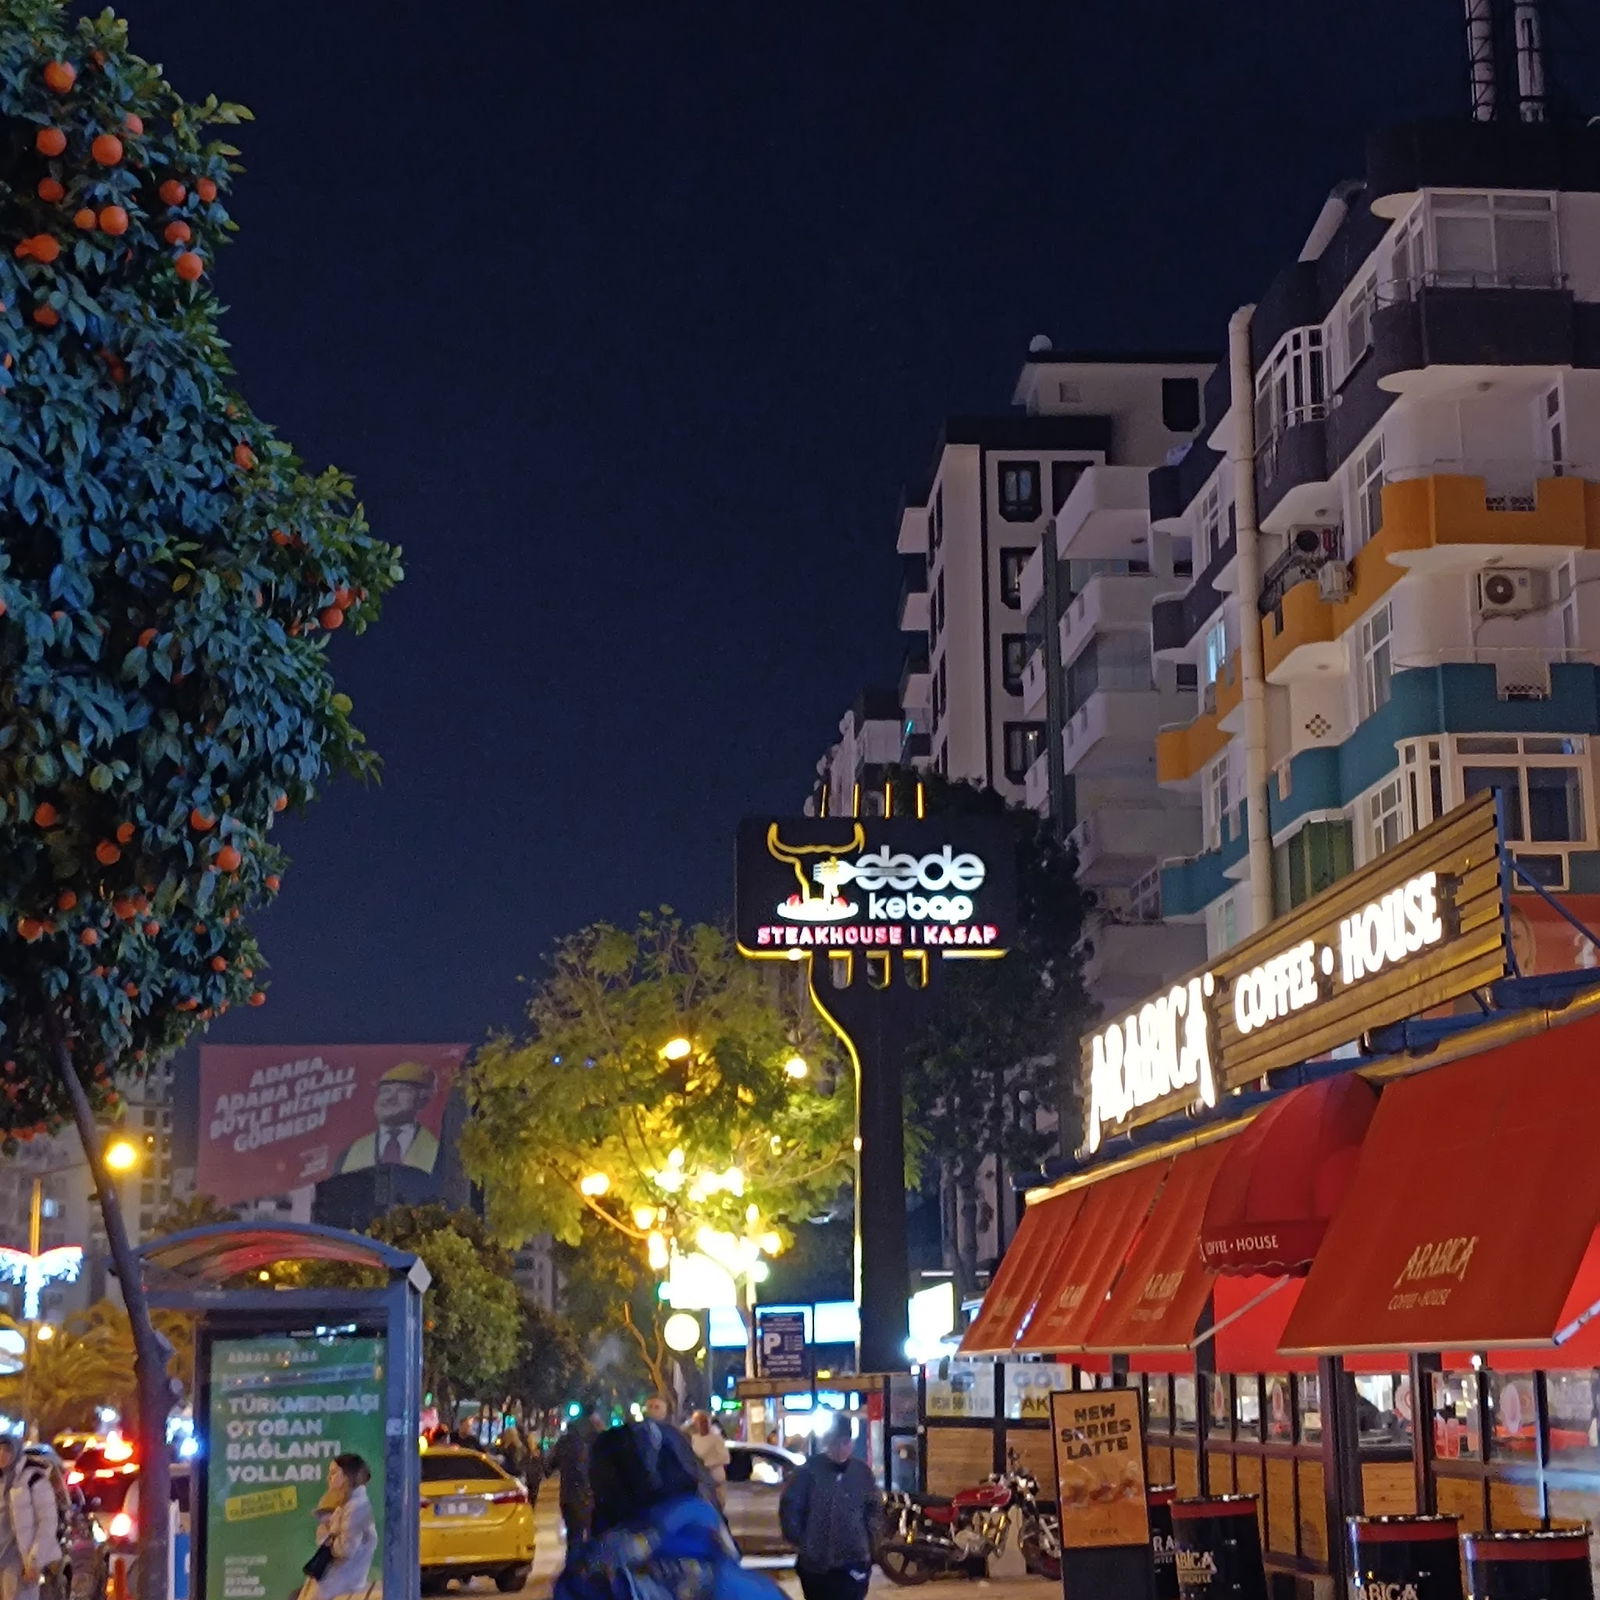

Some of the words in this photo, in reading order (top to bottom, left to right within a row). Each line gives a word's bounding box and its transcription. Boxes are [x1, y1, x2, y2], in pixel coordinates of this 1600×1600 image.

[856, 845, 986, 891] dede
[869, 893, 974, 925] kebap
[757, 926, 902, 944] STEAKHOUSE
[923, 926, 999, 944] KASAP
[1234, 940, 1318, 1034] COFFEE
[1340, 871, 1443, 985] HOUSE
[1236, 1234, 1279, 1251] HOUSE
[763, 1332, 782, 1355] P
[1074, 1403, 1116, 1424] NEW
[226, 1418, 323, 1438] OTOBAN
[1061, 1418, 1133, 1443] SERIES
[226, 1438, 342, 1461] BAĞLANTI
[1066, 1436, 1129, 1461] LATTE
[226, 1463, 322, 1483] YOLLARI
